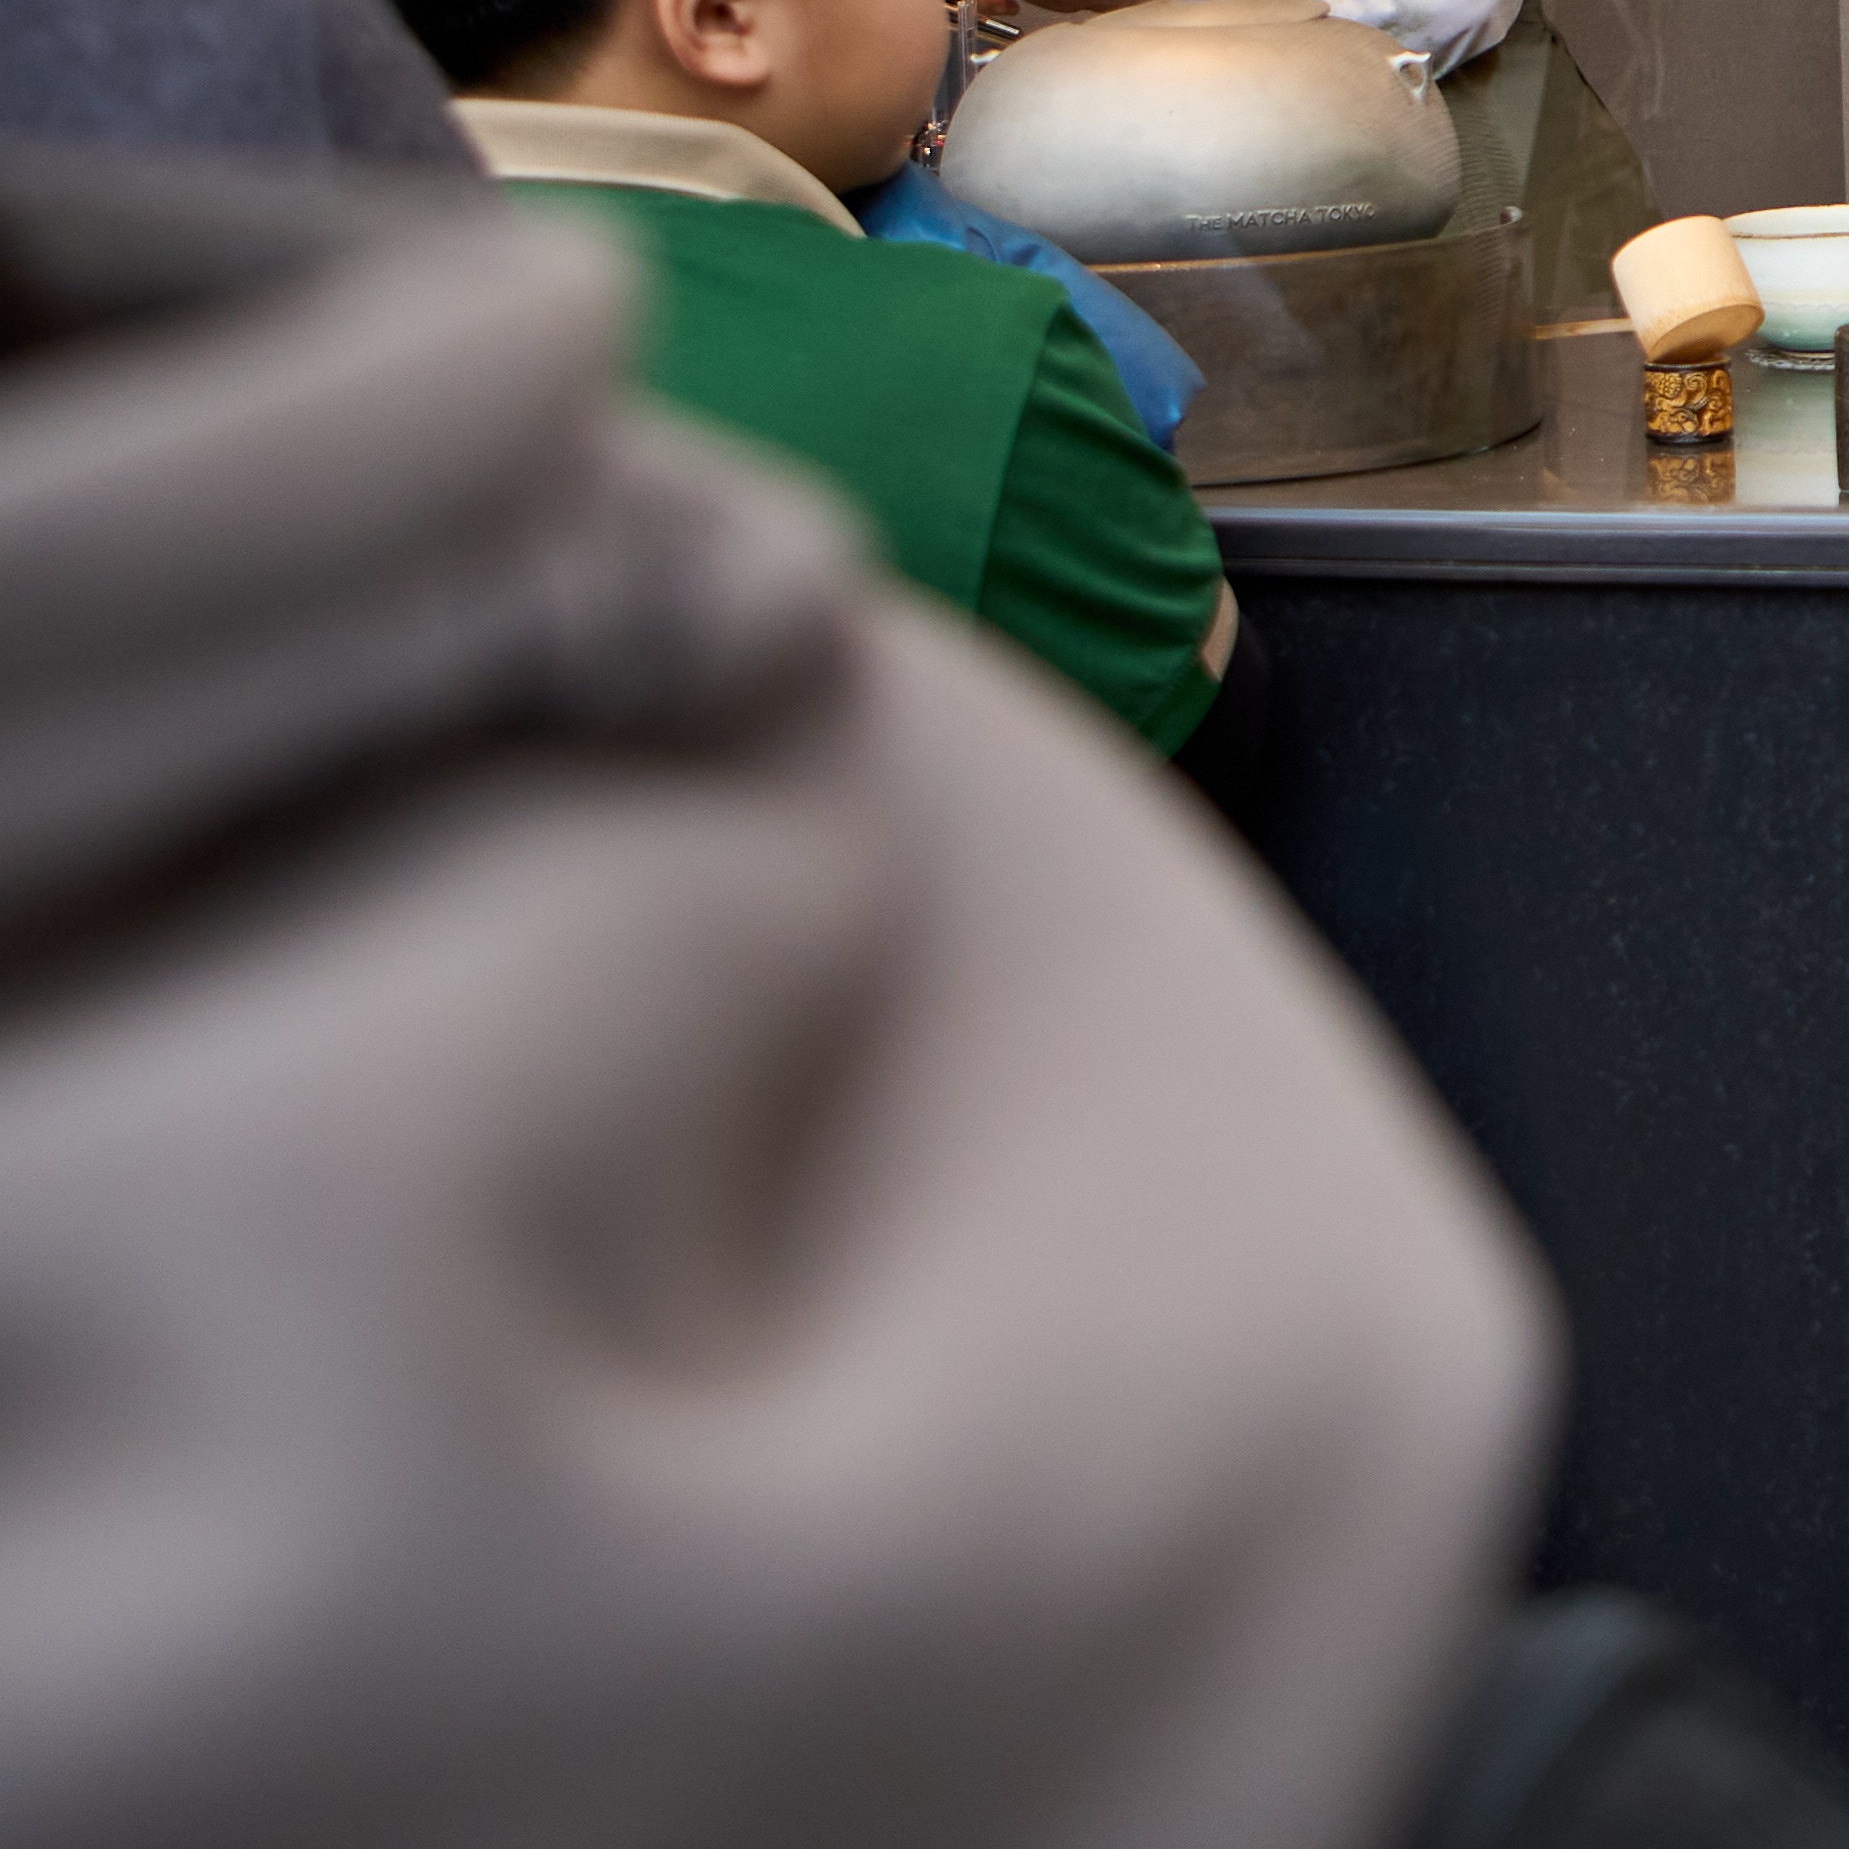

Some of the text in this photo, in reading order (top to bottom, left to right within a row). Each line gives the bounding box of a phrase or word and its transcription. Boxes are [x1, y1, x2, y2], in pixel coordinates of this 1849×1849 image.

[1185, 202, 1376, 232] THE MATCHA TOKYO
